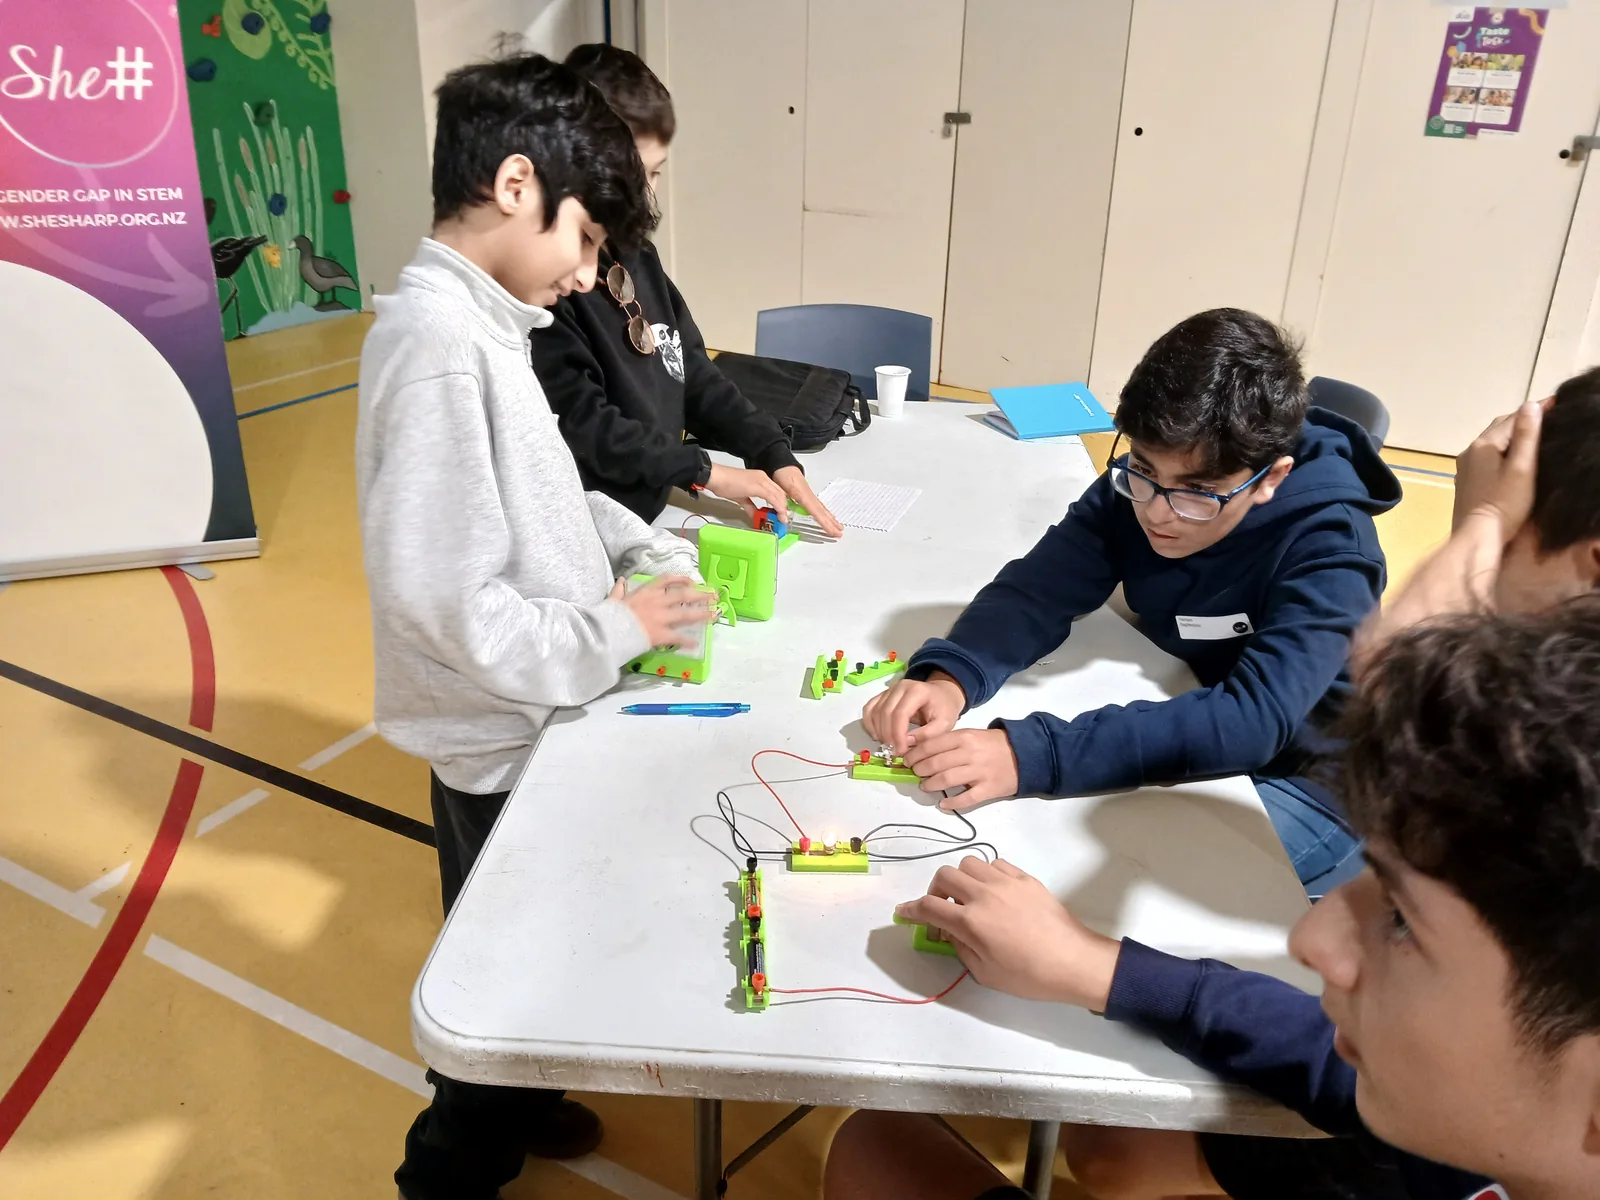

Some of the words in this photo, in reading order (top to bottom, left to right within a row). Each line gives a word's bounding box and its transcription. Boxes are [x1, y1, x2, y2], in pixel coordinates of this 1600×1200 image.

[1, 45, 153, 100] She#
[0, 189, 69, 203] GENDER
[73, 188, 111, 202] GAP
[114, 188, 134, 202] IN
[137, 187, 183, 201] STEM
